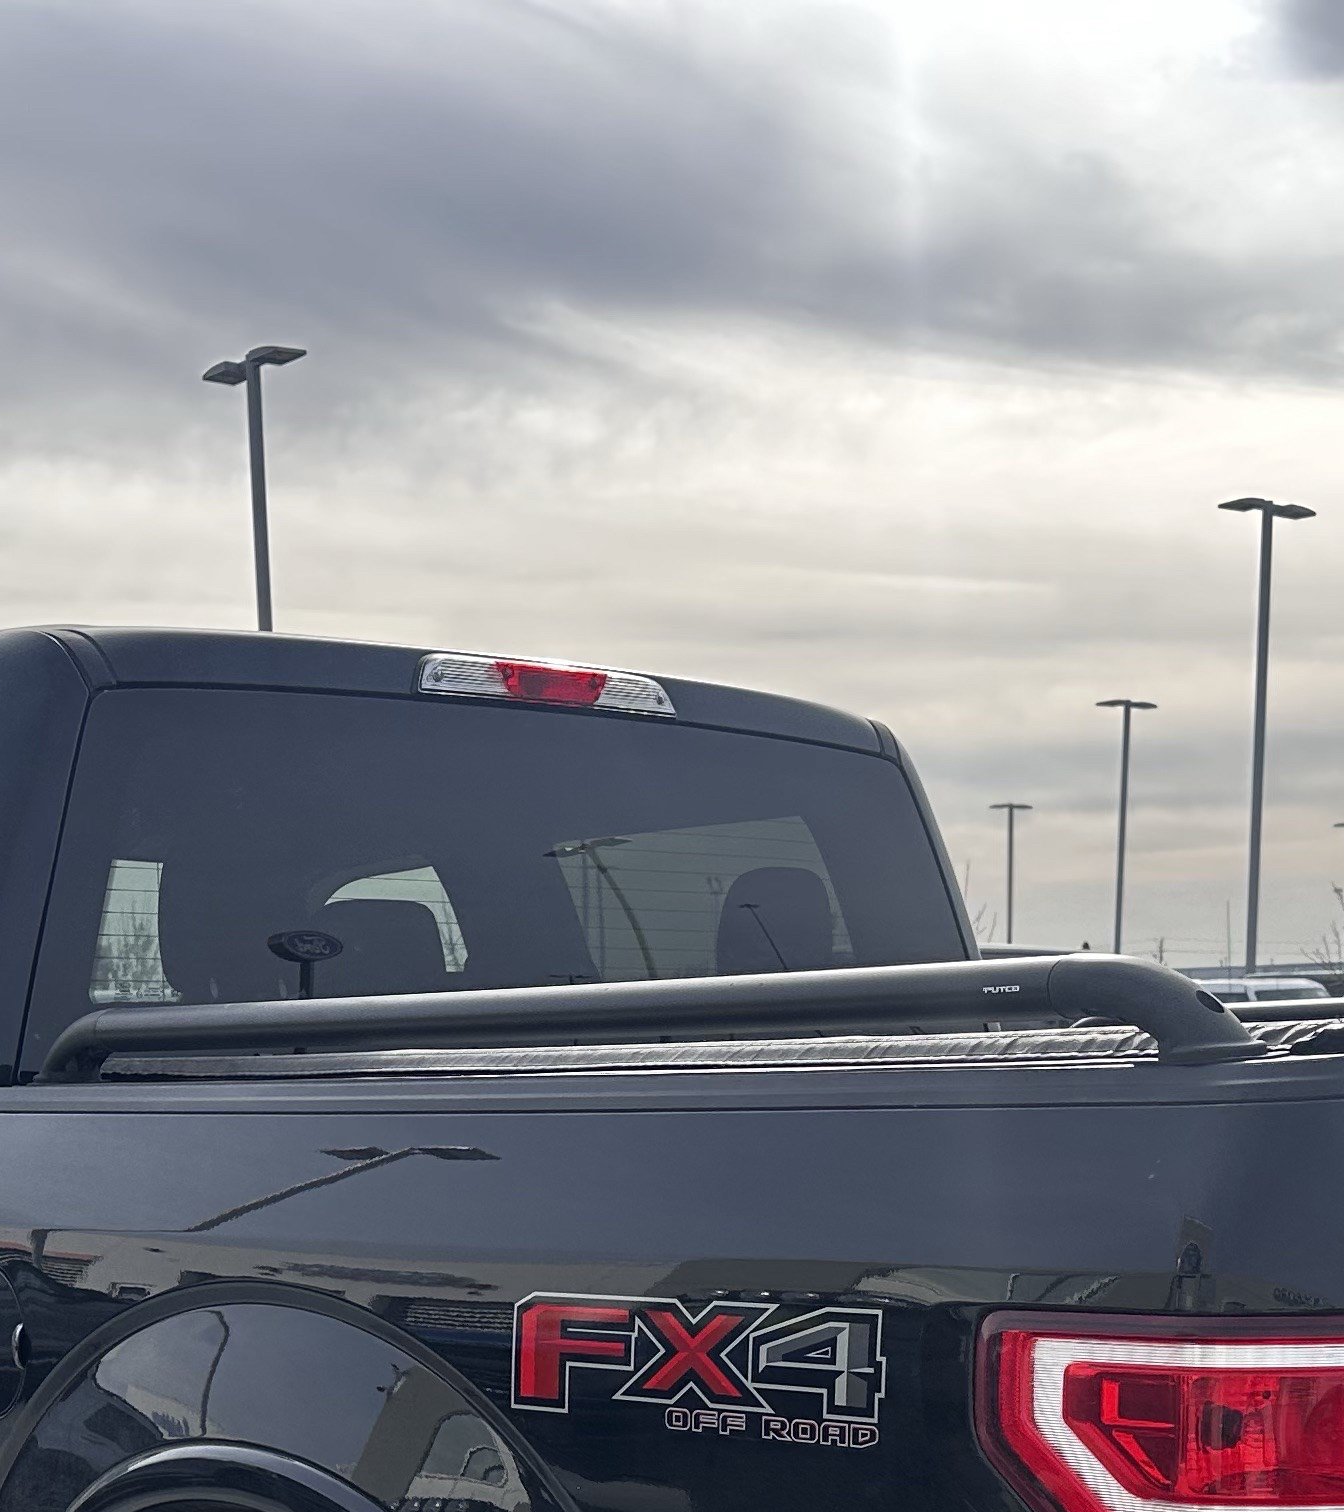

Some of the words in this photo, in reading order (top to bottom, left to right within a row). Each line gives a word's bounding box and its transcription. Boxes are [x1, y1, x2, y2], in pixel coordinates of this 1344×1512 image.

[511, 1291, 886, 1423] FX4
[665, 1407, 746, 1435] OFF
[761, 1415, 879, 1449] ROAD
